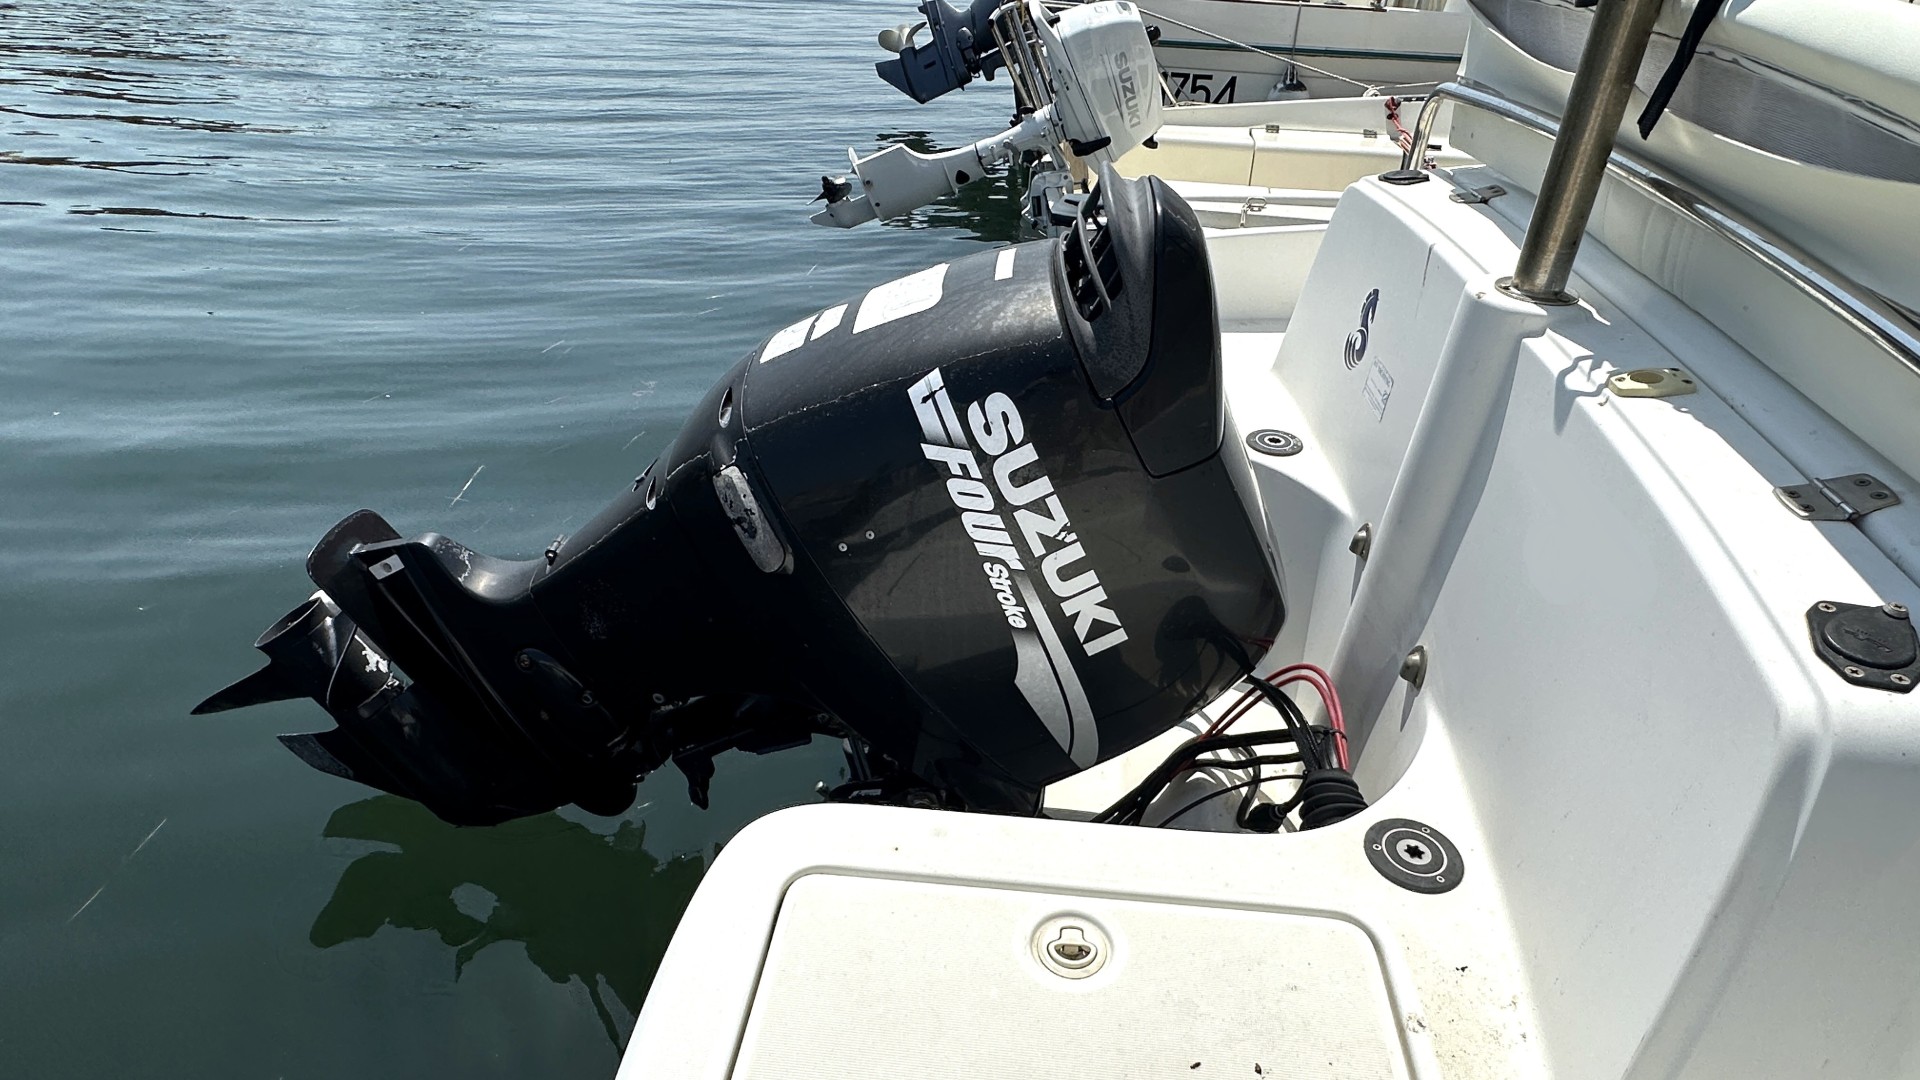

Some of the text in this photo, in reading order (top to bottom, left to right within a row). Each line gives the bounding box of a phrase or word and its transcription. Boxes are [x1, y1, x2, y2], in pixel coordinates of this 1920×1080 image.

[1114, 51, 1141, 129] SUZUKI
[967, 391, 1129, 657] SUZUKI
[982, 561, 1028, 629] Stroke
